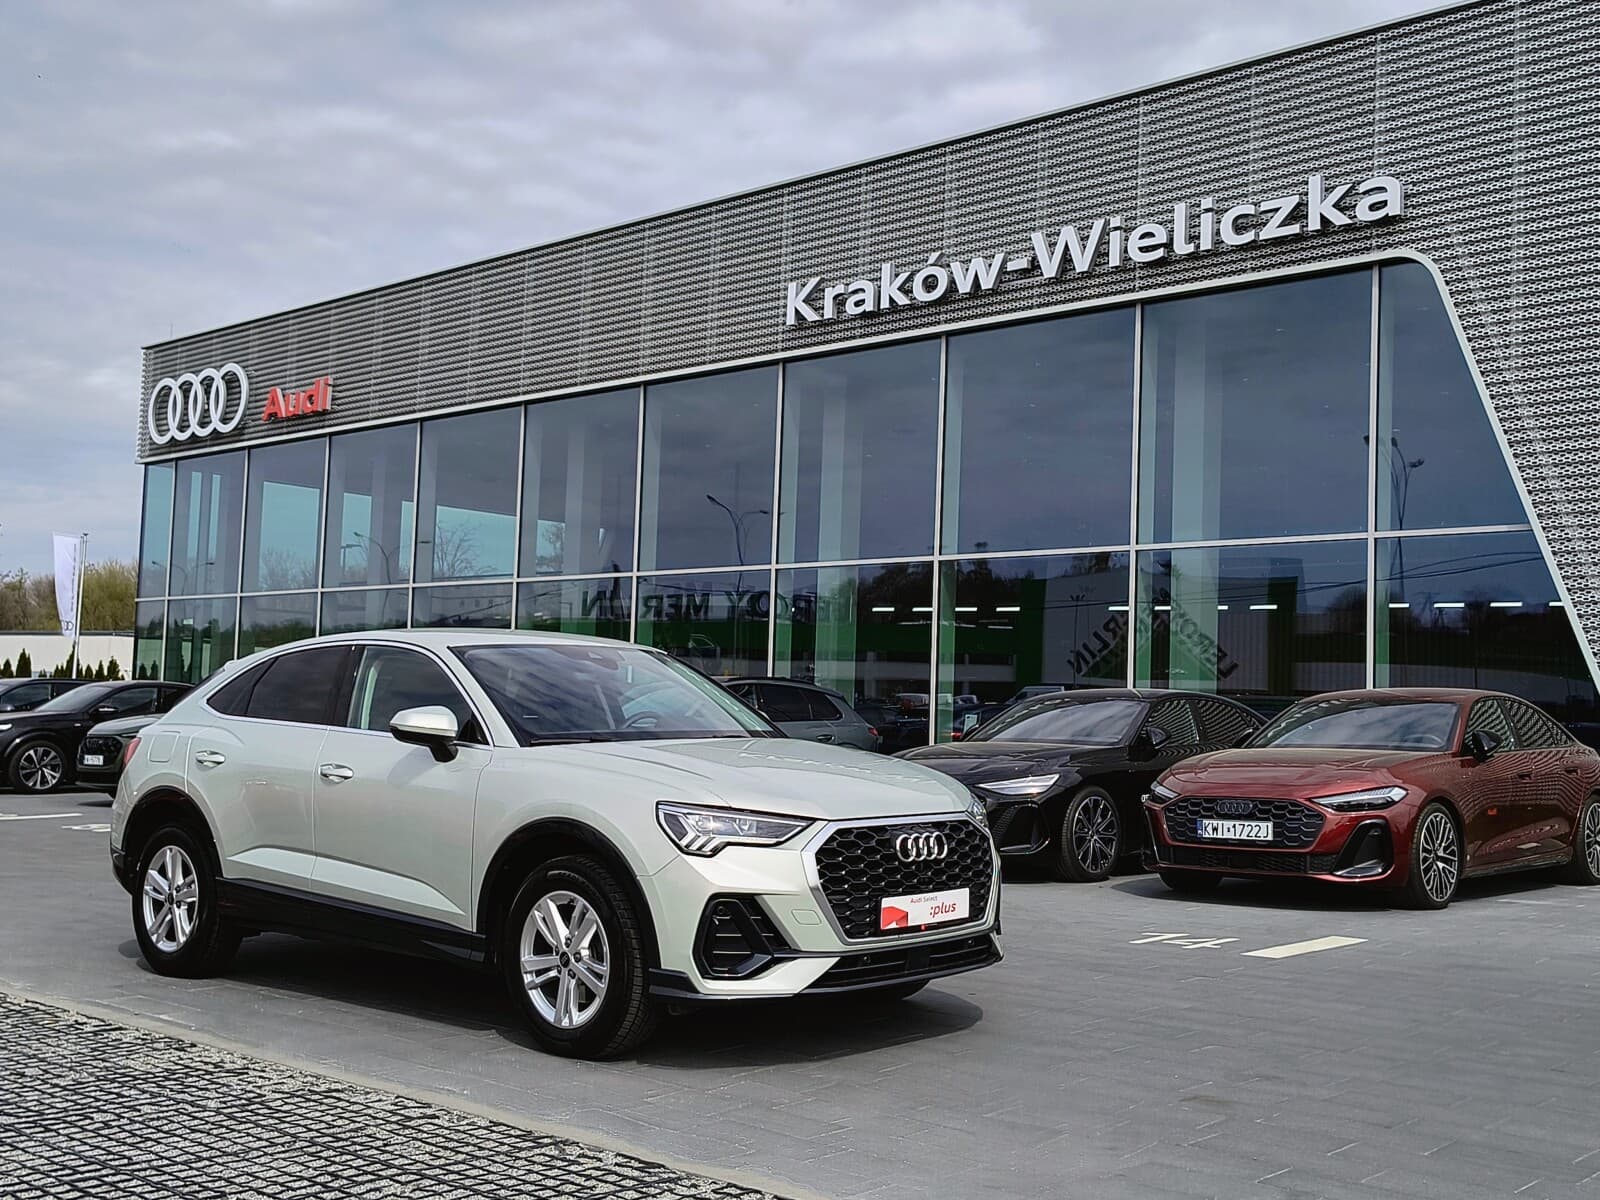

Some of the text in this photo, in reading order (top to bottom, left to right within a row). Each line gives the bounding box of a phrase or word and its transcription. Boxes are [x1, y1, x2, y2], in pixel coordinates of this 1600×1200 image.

[786, 174, 1406, 326] Kraków-Wieliczka
[263, 377, 333, 421] Audi
[1203, 822, 1224, 837] KWI
[1231, 823, 1269, 839] 1722J
[929, 902, 957, 918] :plus
